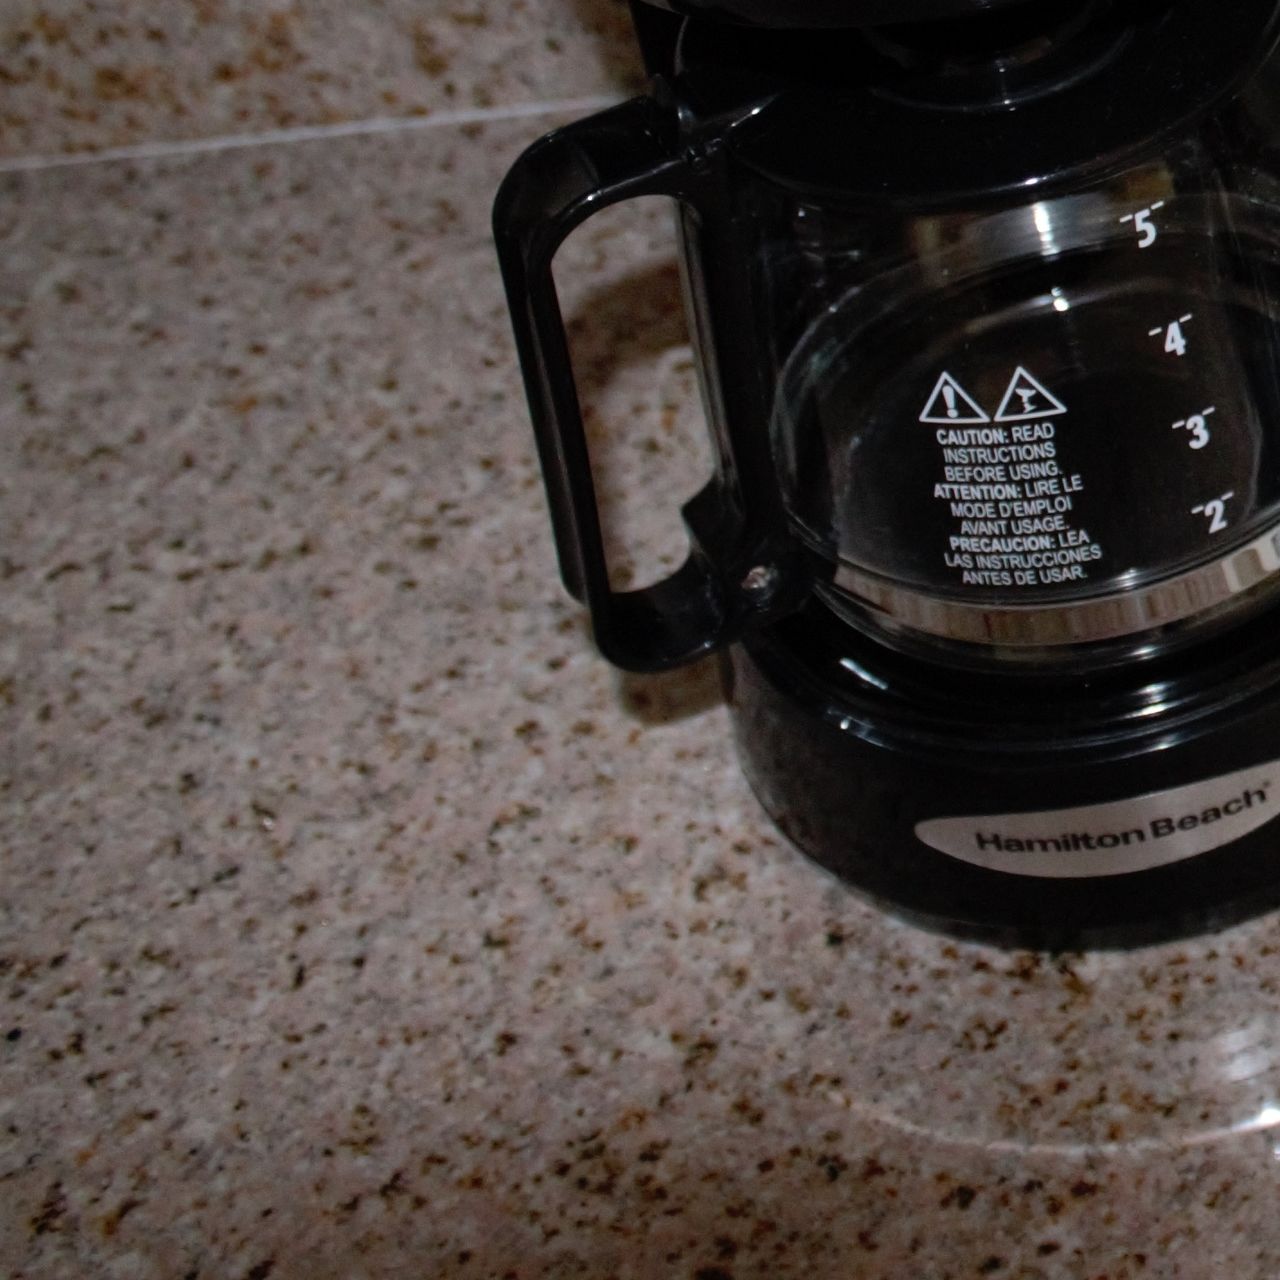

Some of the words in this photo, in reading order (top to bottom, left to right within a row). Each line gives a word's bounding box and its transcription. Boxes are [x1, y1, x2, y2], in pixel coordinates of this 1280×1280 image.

[1133, 207, 1157, 249] 5
[1163, 320, 1187, 357] 4
[936, 428, 1010, 446] CAUTION:
[1011, 422, 1056, 443] READ
[1185, 414, 1210, 450] 3
[942, 441, 1057, 465] INSTRUCTIONS
[944, 465, 1007, 483] BEFORE
[1009, 460, 1064, 482] USING.
[933, 483, 1023, 501] ATTENTION:
[1024, 479, 1061, 499] LIRE
[1063, 475, 1084, 493] LE
[950, 501, 997, 519] MODE
[999, 496, 1073, 518] D'EMPLOI
[1204, 499, 1228, 534] 2
[960, 520, 1008, 536] AVANT
[1010, 515, 1070, 536] USAGE.
[949, 535, 1057, 553] PRECAUCION:
[1058, 529, 1090, 549] LEA
[944, 552, 974, 569] LAS
[975, 544, 1103, 570] INSTRUCCIONES
[962, 570, 1012, 586] ANTES
[1014, 570, 1038, 586] DE
[1039, 565, 1089, 585] USAR.
[975, 825, 1147, 854] Hamilton
[1148, 788, 1269, 840] Beach
